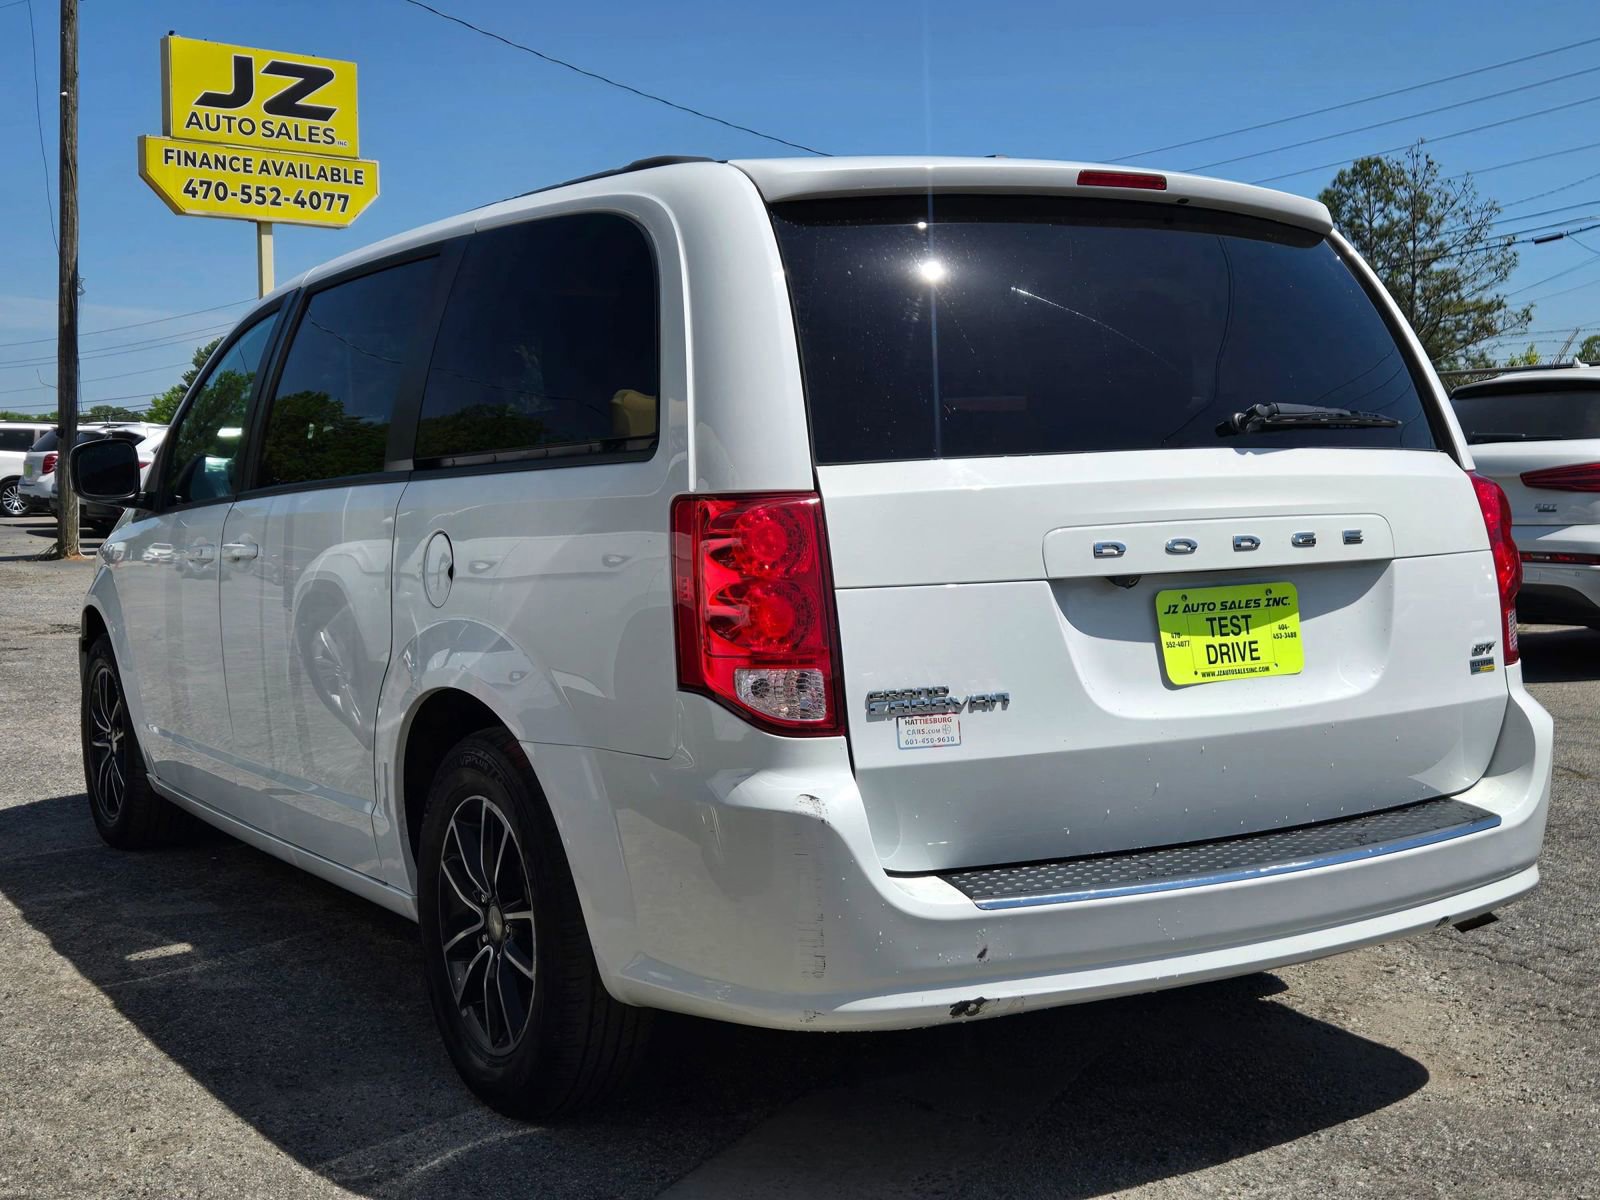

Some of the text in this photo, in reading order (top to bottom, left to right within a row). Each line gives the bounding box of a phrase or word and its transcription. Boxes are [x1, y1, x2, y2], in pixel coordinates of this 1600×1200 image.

[192, 54, 337, 121] JZ
[185, 111, 256, 136] AUTO
[261, 121, 336, 145] SALES
[163, 148, 364, 185] FINANCE AVAILABLE
[183, 179, 350, 213] 470-552-4077
[1093, 529, 1363, 559] DODGE
[1163, 596, 1291, 615] JZ AUTO SALES INC.
[1206, 614, 1253, 637] TEST
[1206, 640, 1261, 665] DRIVE
[867, 692, 1010, 716] CARAVAN
[868, 686, 949, 701] GRAND
[904, 716, 952, 726] HATTIESBURG
